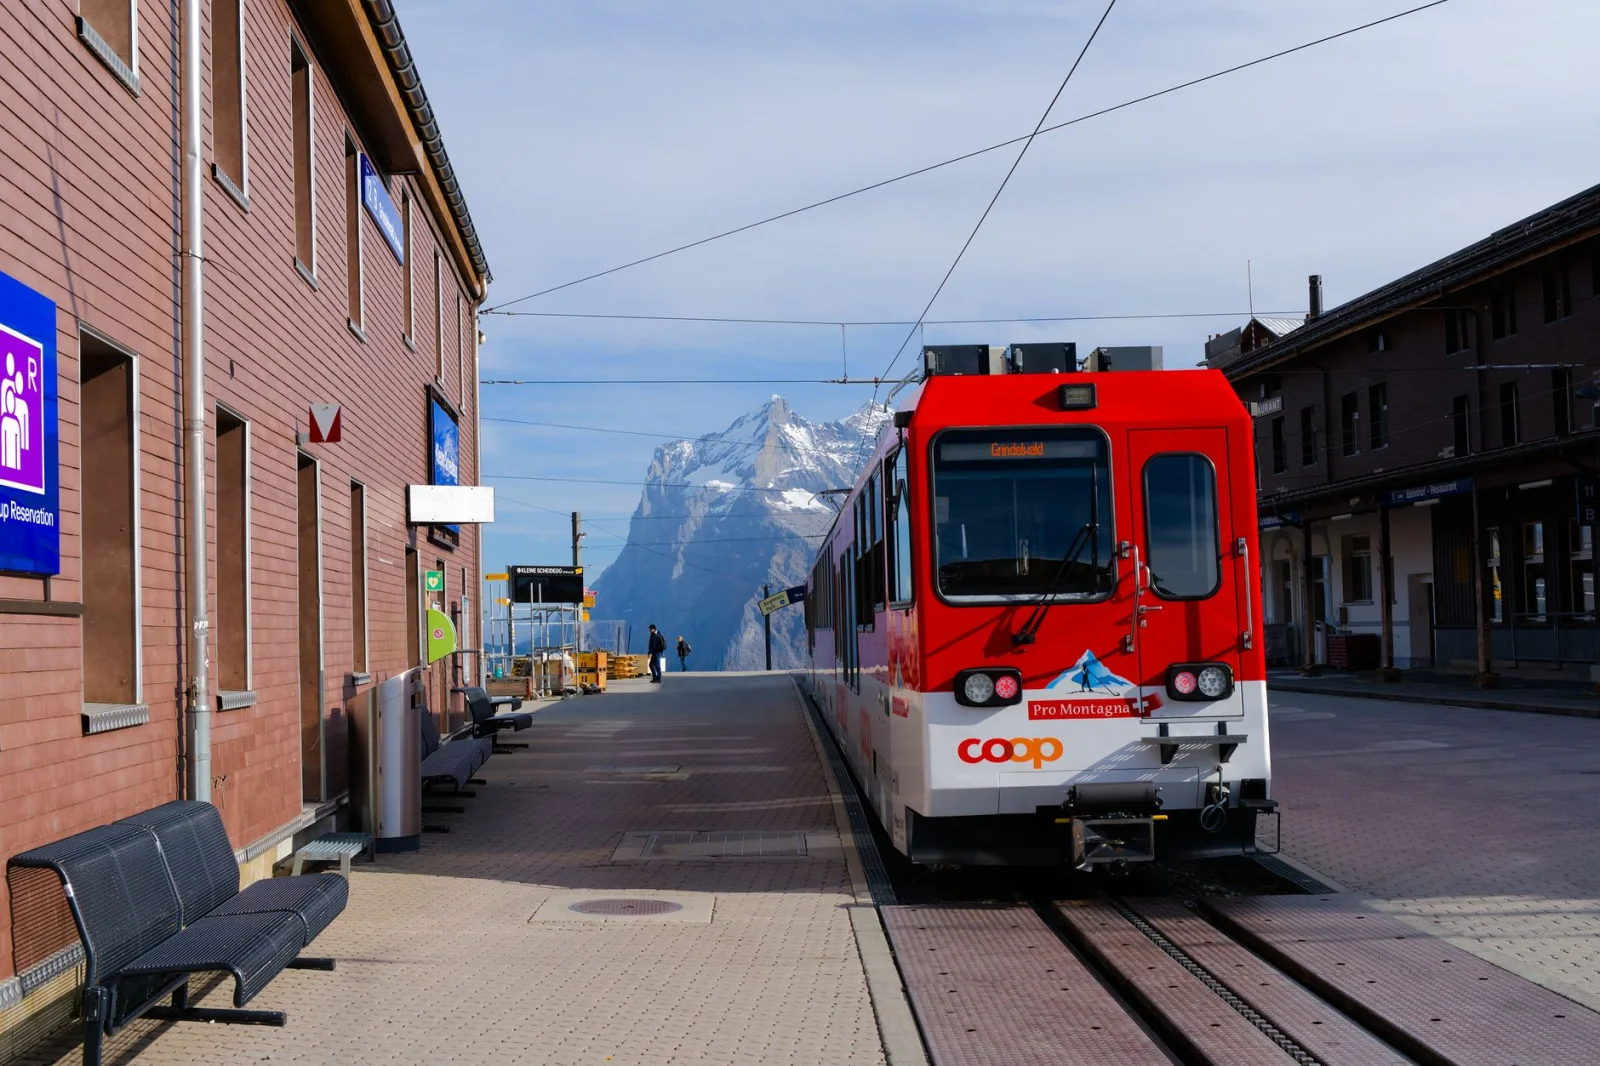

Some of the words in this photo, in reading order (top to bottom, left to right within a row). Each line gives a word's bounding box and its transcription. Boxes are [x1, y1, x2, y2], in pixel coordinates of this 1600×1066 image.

[27, 356, 38, 393] R
[990, 442, 1045, 457] Grindelwald
[1406, 486, 1426, 499] Bahnhof
[1430, 480, 1457, 494] Restaurant
[1584, 484, 1594, 498] 11
[10, 500, 54, 527] Reservation
[1585, 508, 1595, 520] B
[1033, 703, 1056, 717] Pro
[1060, 702, 1130, 718] Montagna
[957, 736, 1064, 770] coop
